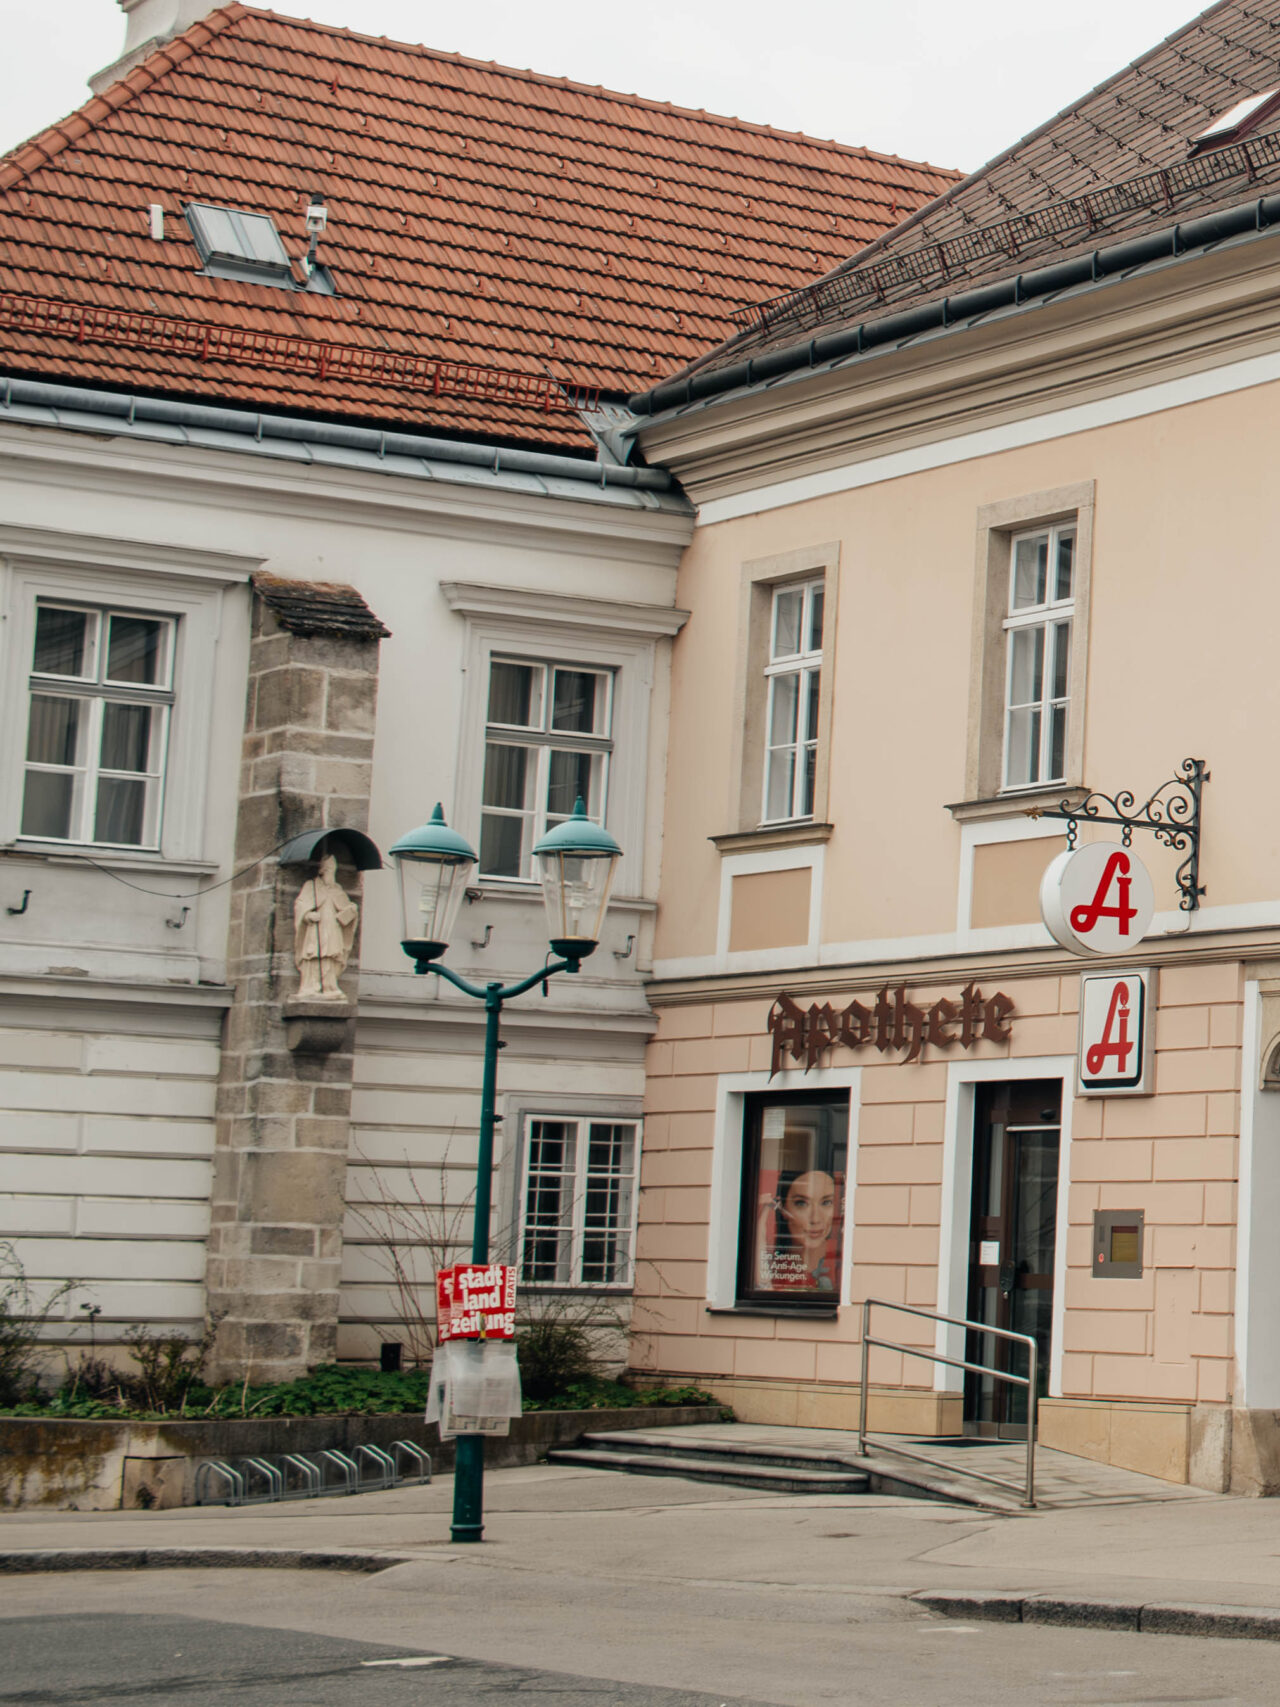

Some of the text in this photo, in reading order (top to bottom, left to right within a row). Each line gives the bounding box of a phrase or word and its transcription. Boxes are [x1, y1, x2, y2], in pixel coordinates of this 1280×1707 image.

[767, 979, 1016, 1085] Apotheke
[774, 1250, 802, 1261] Serum.
[458, 1264, 504, 1290] stadt
[506, 1267, 516, 1307] GRATIS
[463, 1285, 501, 1311] land
